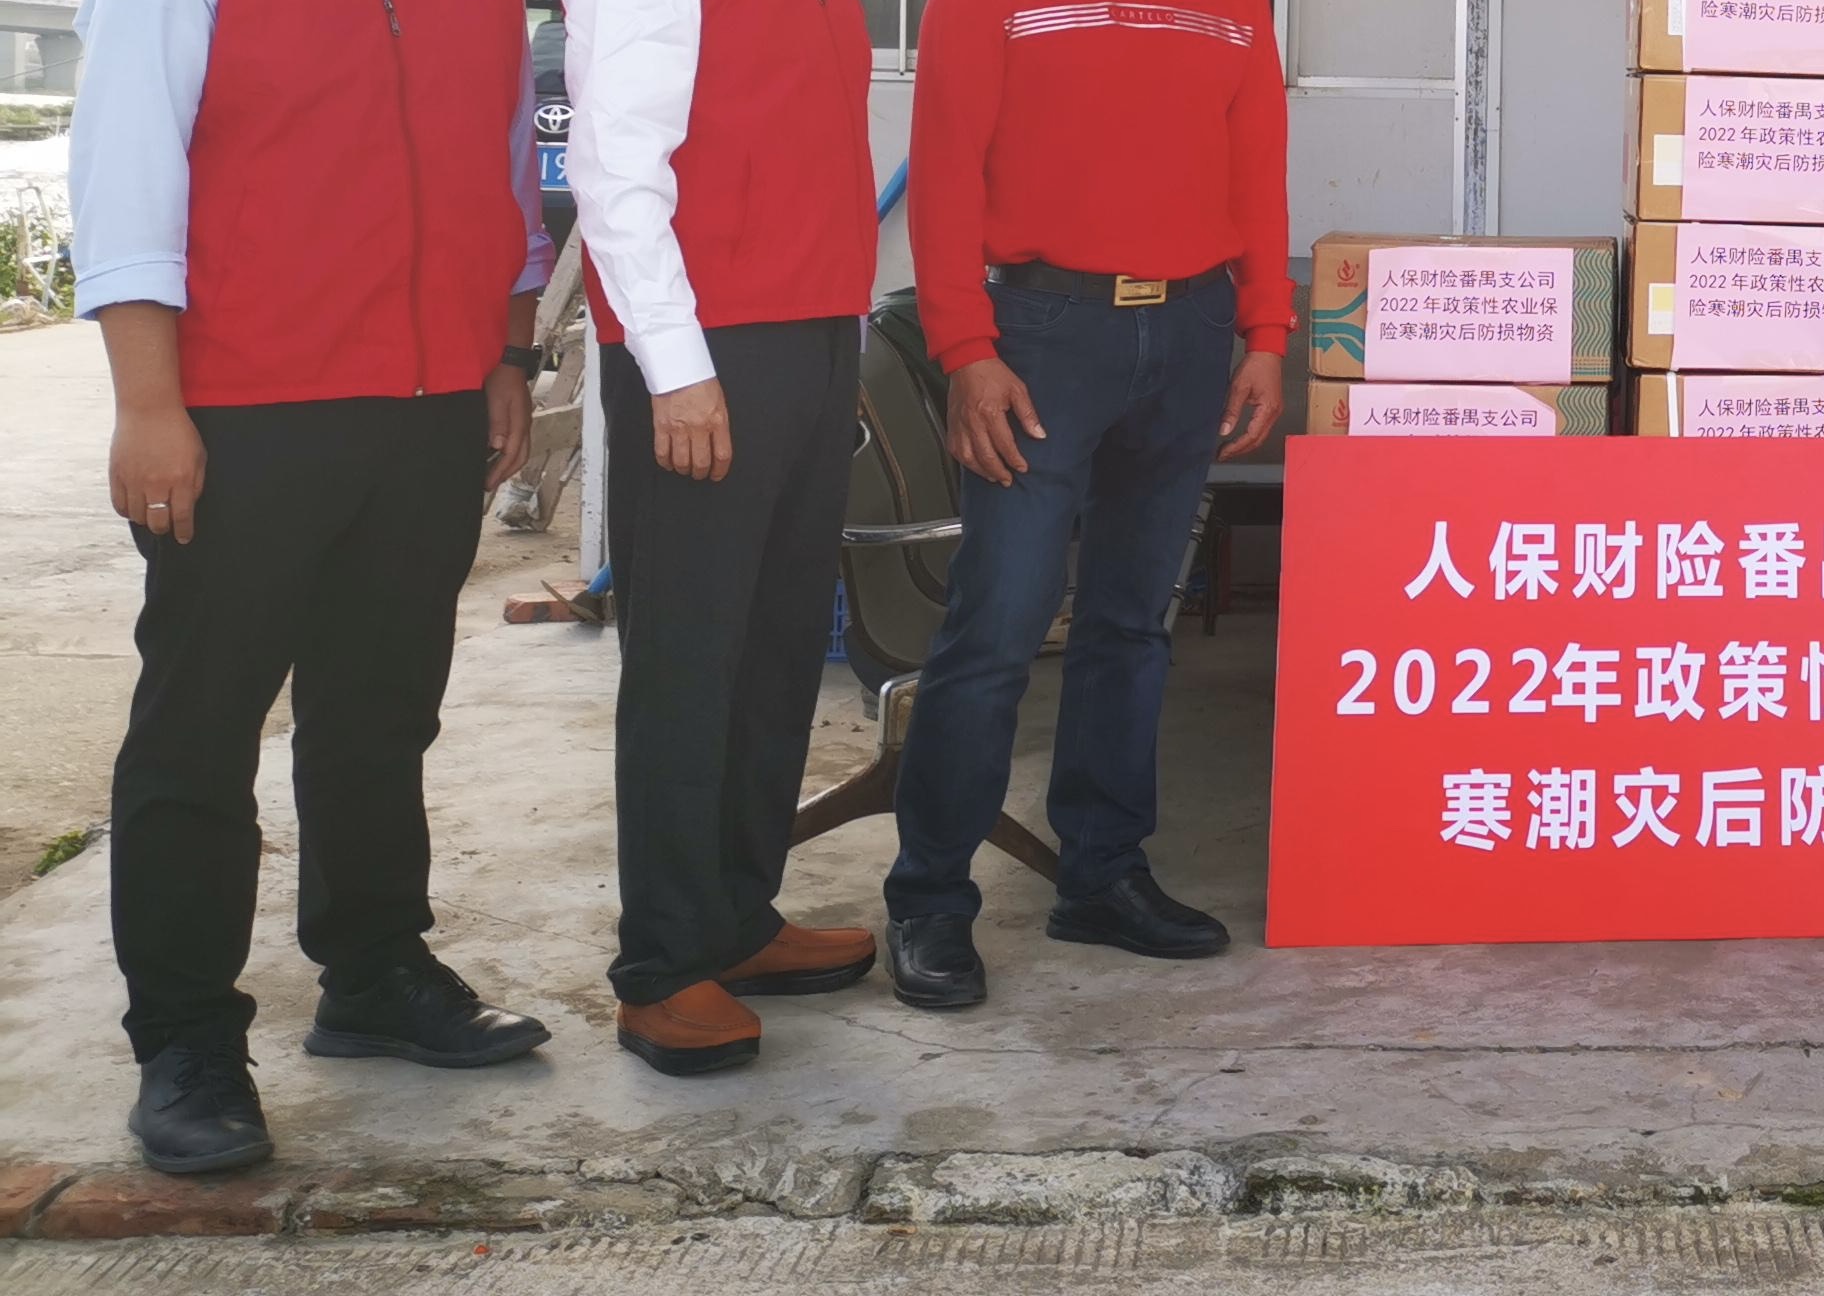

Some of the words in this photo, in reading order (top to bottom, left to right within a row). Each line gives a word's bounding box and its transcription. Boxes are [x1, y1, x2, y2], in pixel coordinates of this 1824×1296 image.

[1381, 269, 1556, 290] 人保财险番禺支公司
[1379, 322, 1555, 342] 险寒潮灾后防损物资
[1363, 408, 1539, 429] 人保财险番禺支公司
